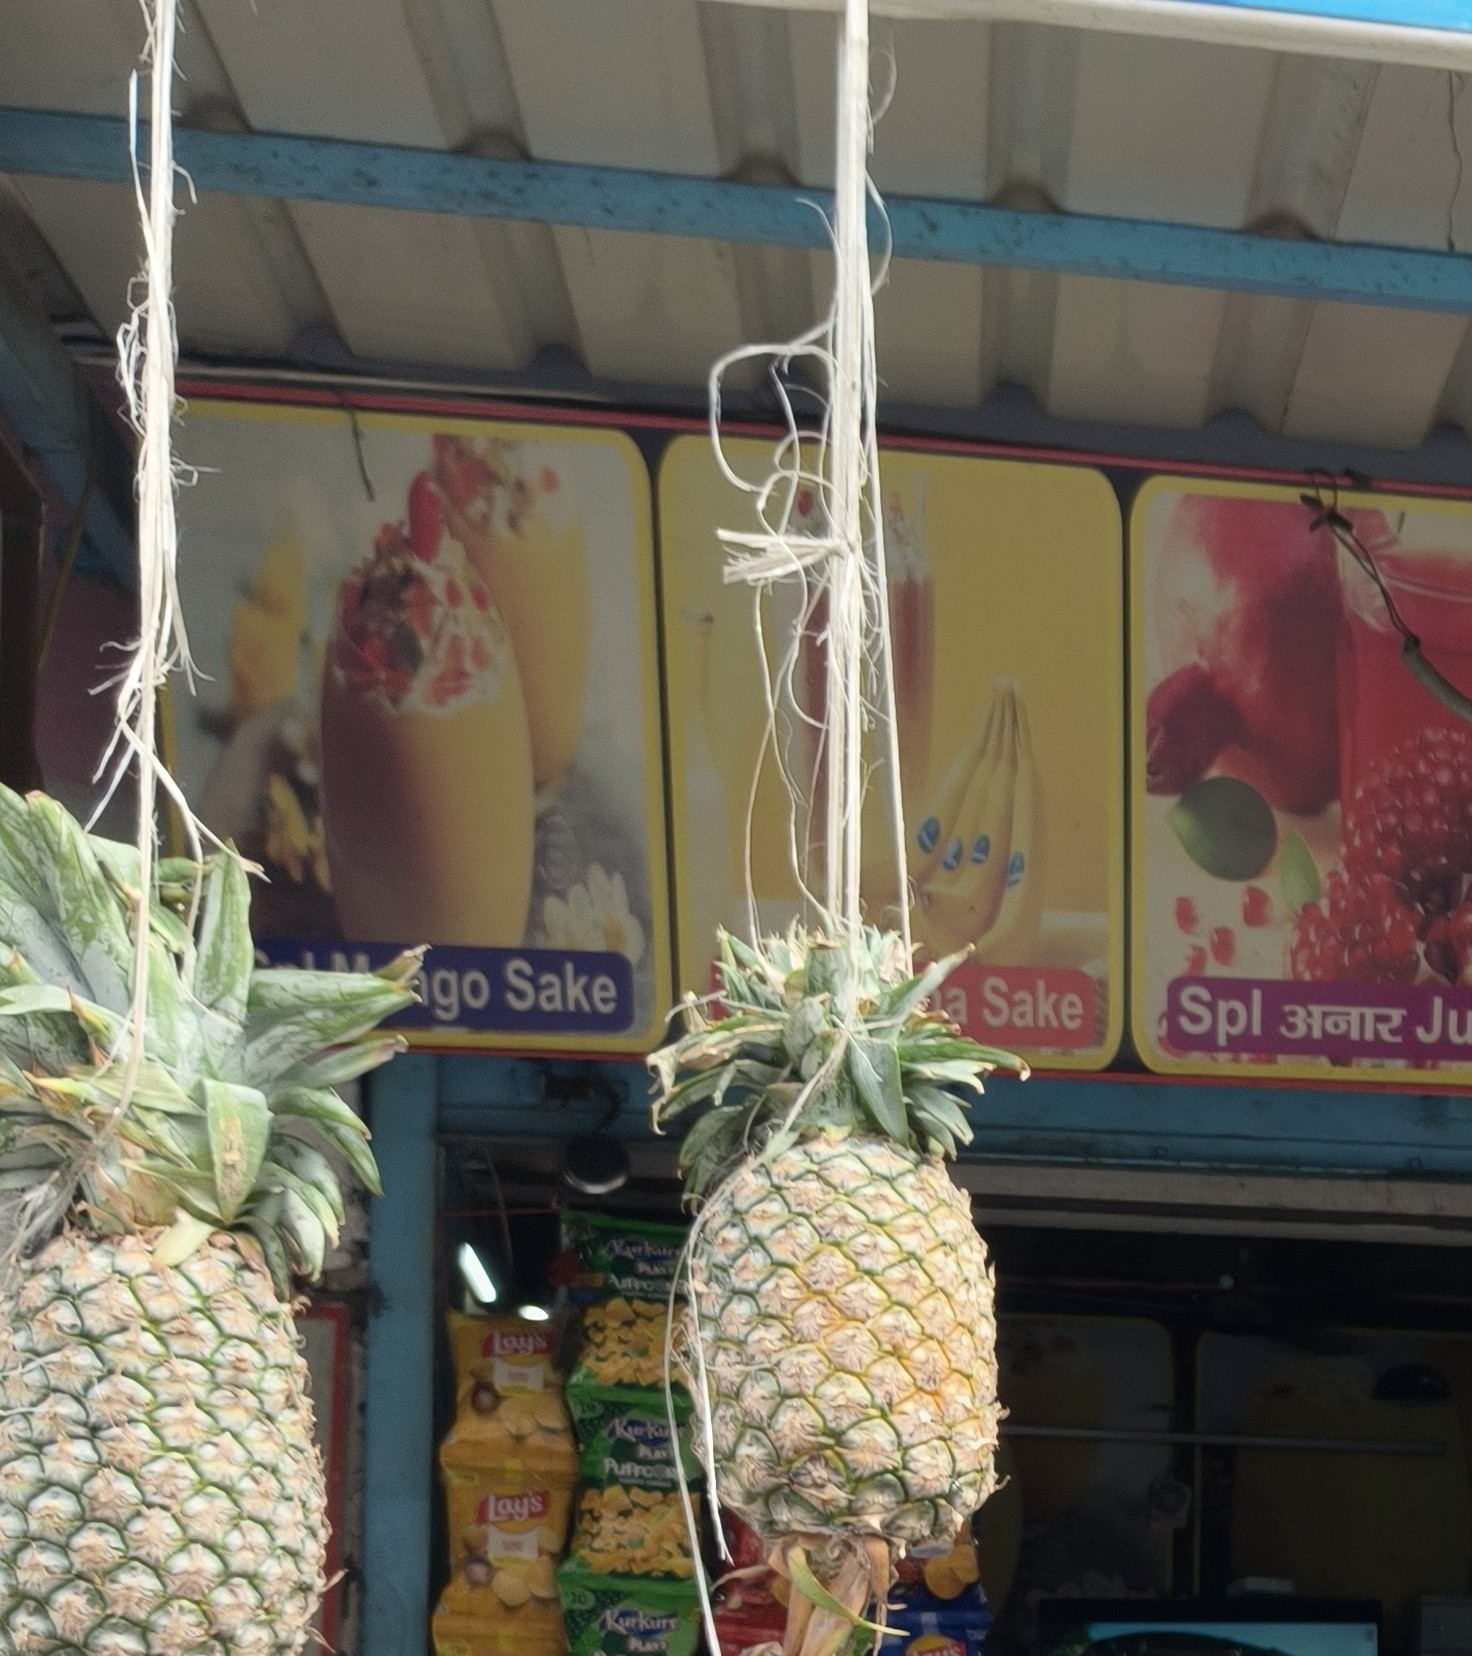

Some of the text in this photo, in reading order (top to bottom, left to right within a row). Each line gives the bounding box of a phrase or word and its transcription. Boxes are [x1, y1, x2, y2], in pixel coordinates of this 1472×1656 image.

[505, 957, 618, 1014] Sake
[982, 975, 1084, 1030] Sake
[1178, 985, 1262, 1046] Spl
[1278, 1003, 1408, 1043] अनार
[493, 1330, 550, 1356] Lay's
[487, 1491, 544, 1522] Lay's
